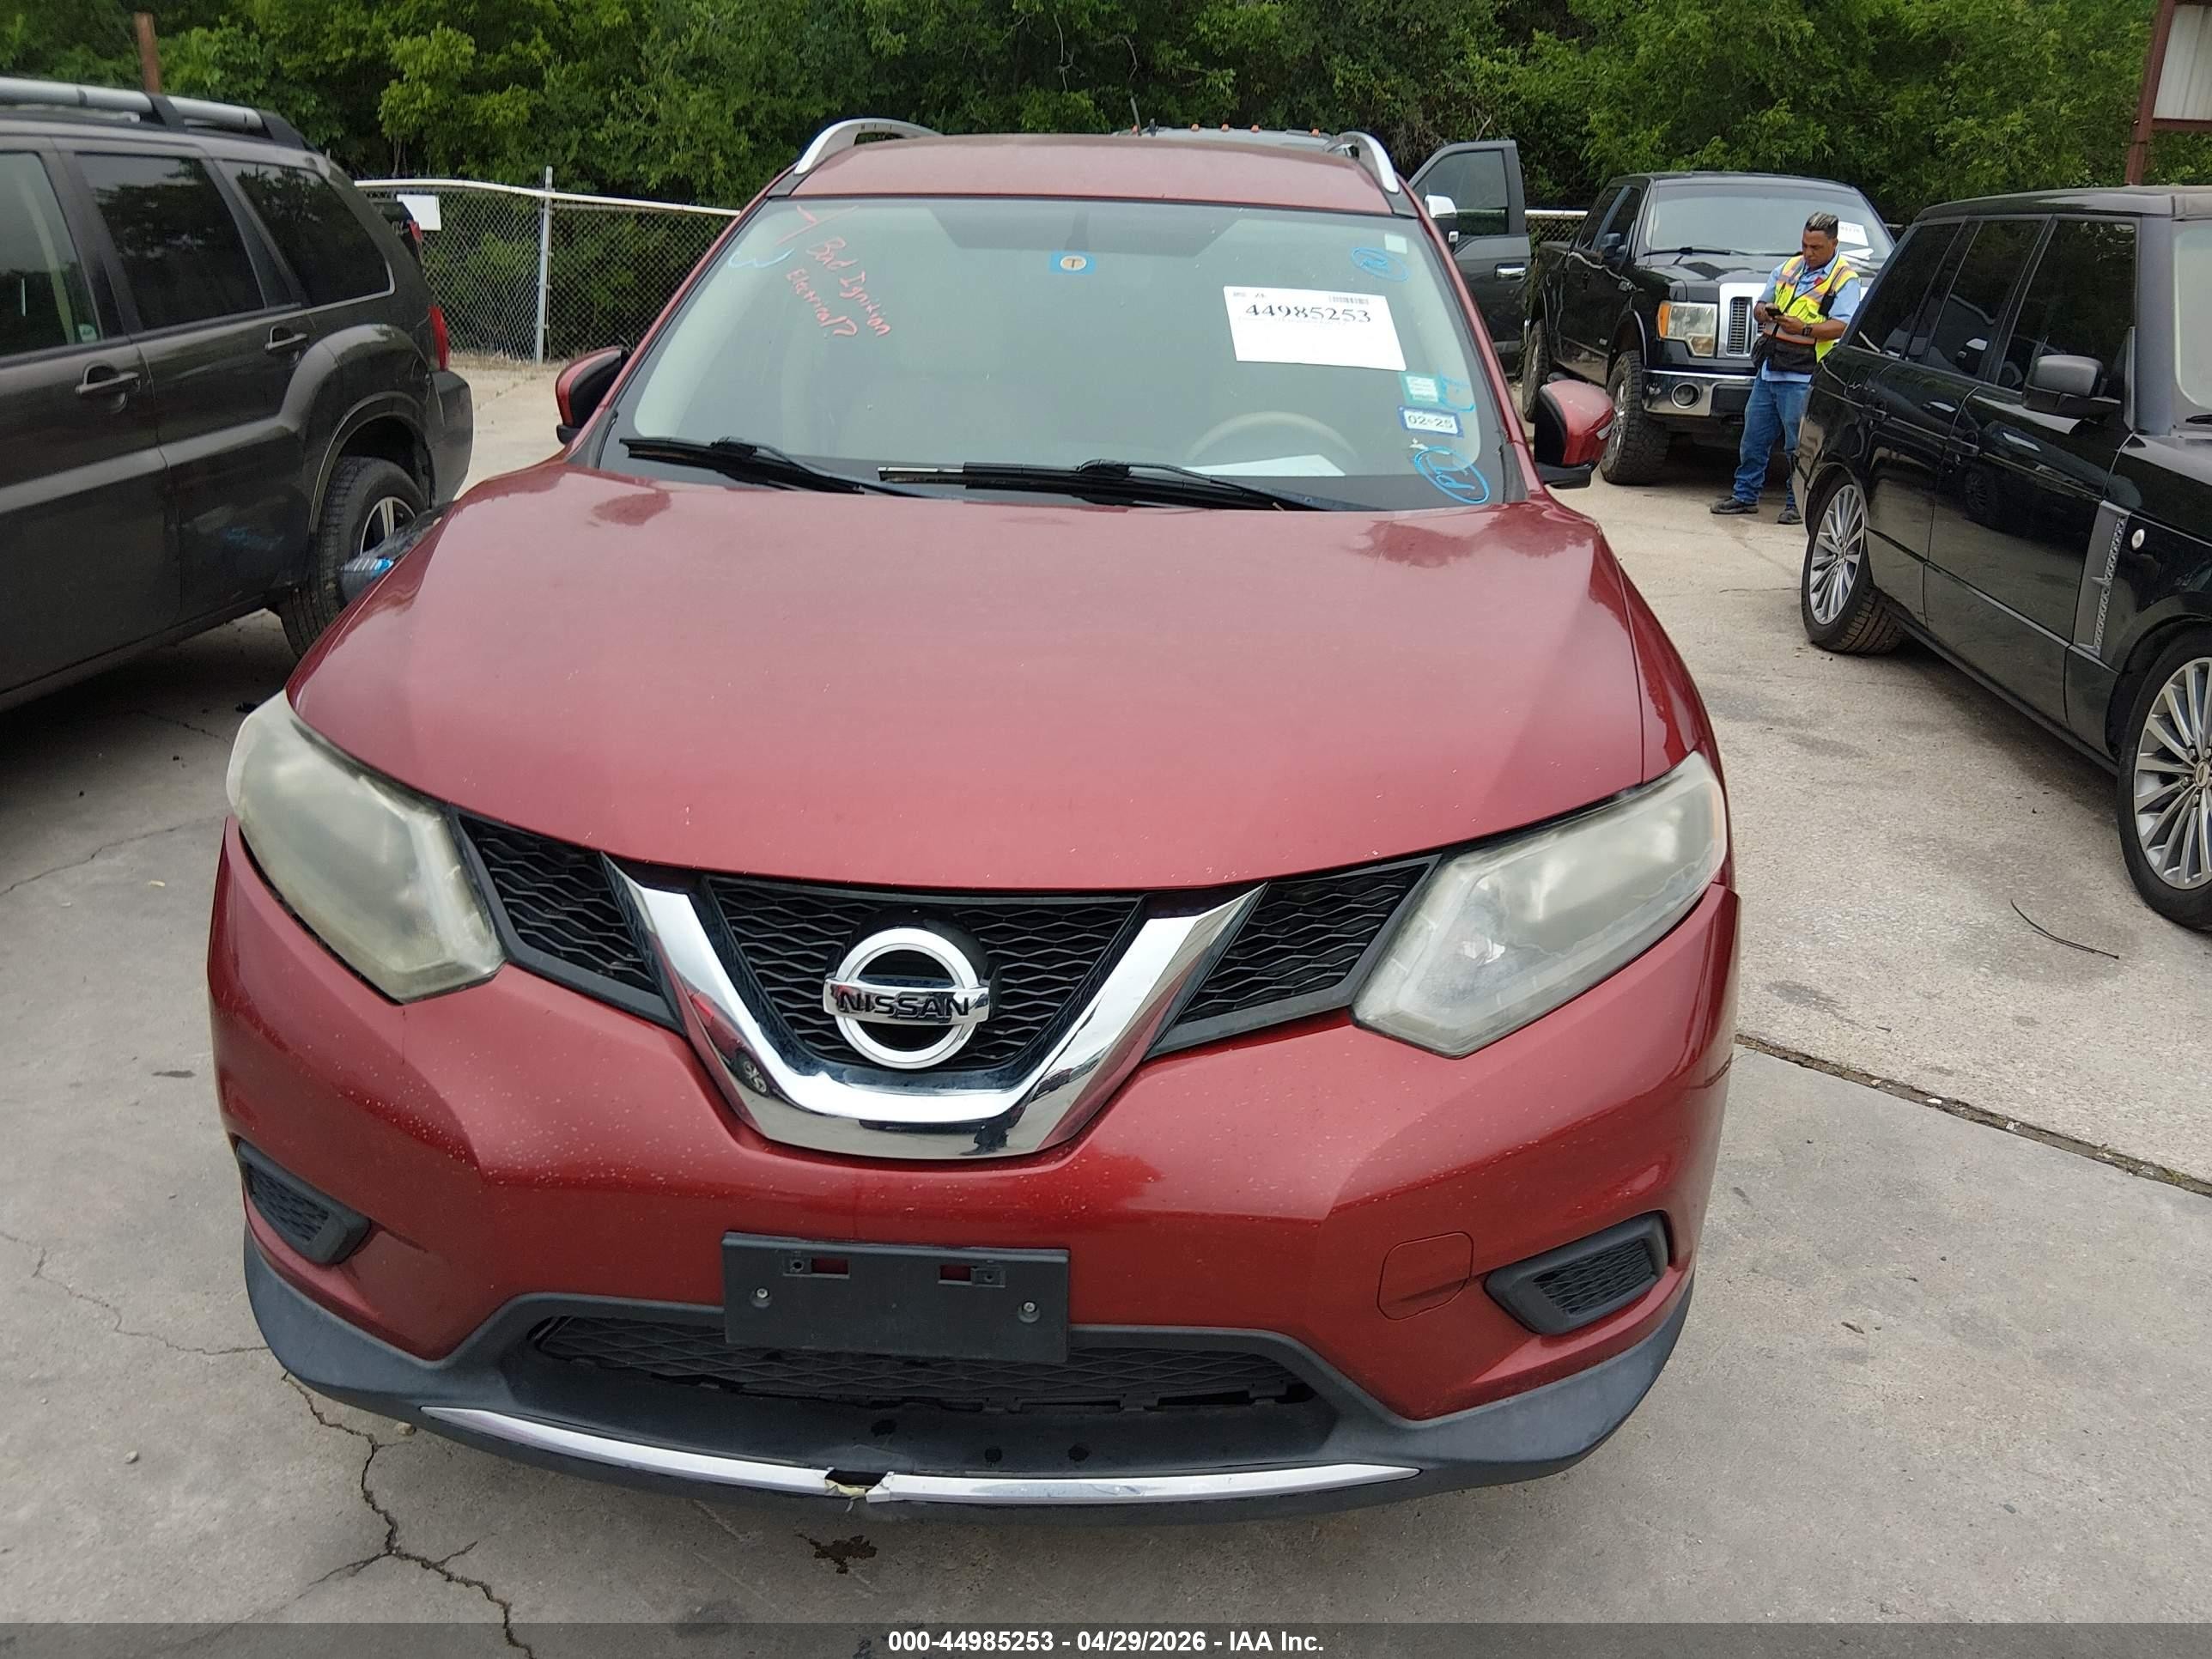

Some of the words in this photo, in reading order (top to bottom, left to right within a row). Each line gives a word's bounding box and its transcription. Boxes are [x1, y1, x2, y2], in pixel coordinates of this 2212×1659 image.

[805, 236, 859, 272] Bad
[838, 270, 891, 337] Ignition
[1245, 304, 1371, 323] 44985253
[837, 990, 969, 1017] NISSAN
